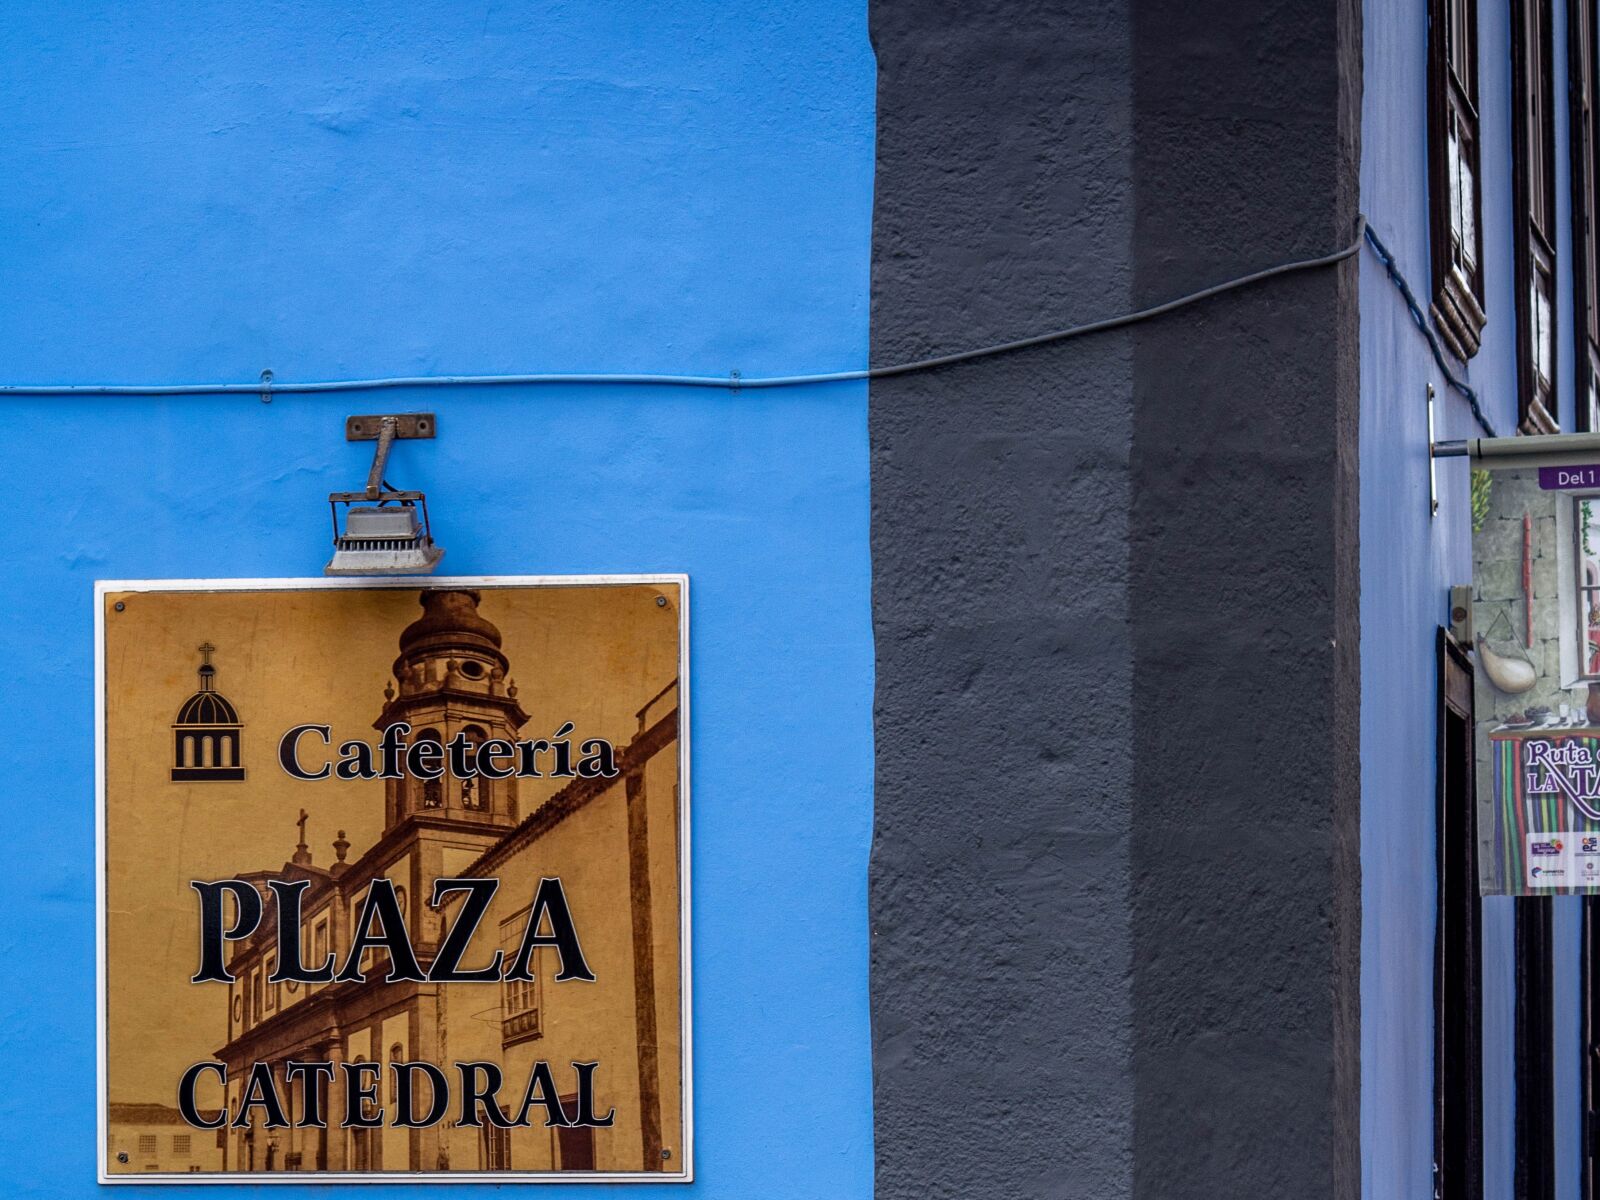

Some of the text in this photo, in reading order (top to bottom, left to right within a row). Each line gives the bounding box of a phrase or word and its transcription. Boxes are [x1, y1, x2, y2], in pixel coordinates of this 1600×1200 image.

[1558, 471, 1585, 485] Del
[278, 722, 619, 780] Cafetería
[1527, 740, 1592, 766] Ruta
[1527, 764, 1600, 799] LA T
[190, 876, 597, 984] PLAZA
[177, 1060, 616, 1129] CATEDRAL
